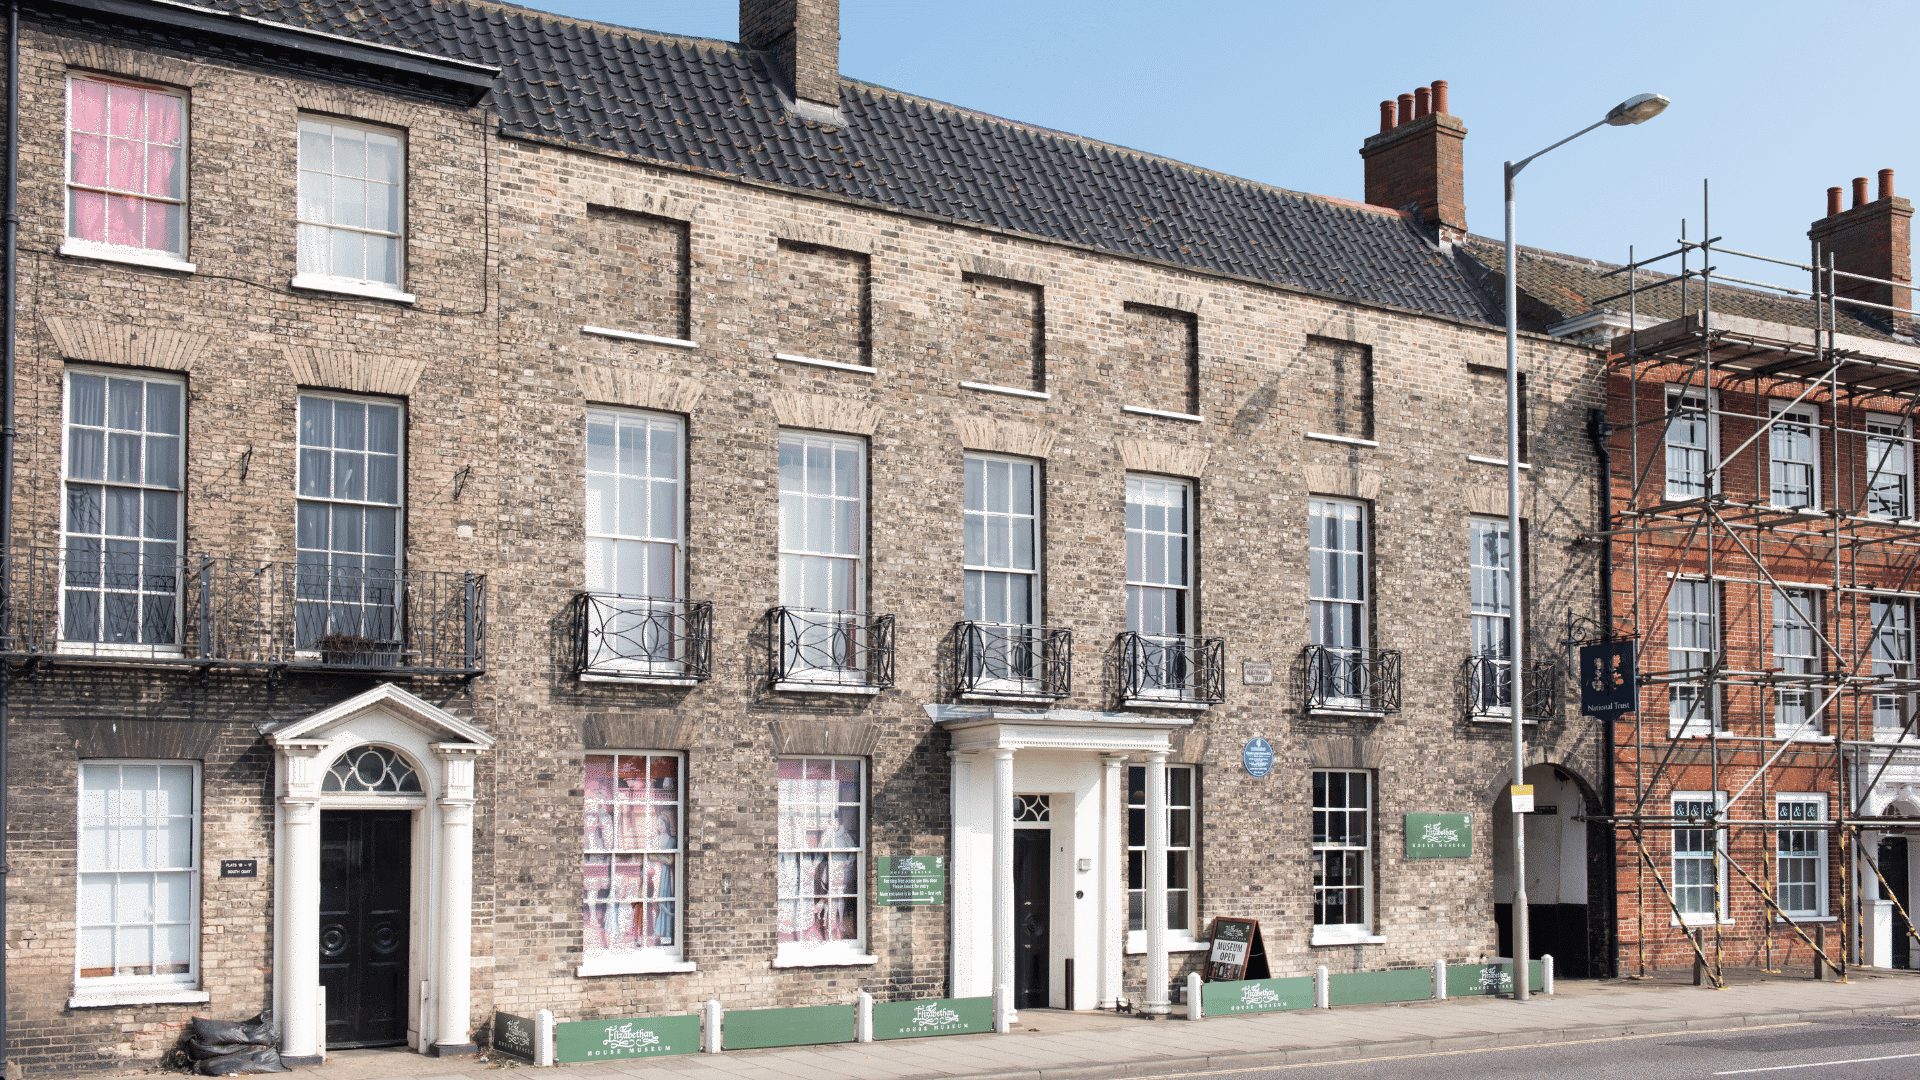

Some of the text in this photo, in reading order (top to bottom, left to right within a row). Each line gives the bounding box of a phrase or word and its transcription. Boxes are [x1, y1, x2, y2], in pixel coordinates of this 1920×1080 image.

[1587, 701, 1613, 711] National
[1216, 941, 1243, 952] MUSEUM
[1220, 951, 1236, 962] OPEN
[1241, 983, 1279, 1005] Elizabethan
[912, 1002, 959, 1026] Elizabethan
[933, 1023, 969, 1031] MUSEUM
[603, 1022, 660, 1048] Elizabethan
[587, 1045, 671, 1057] HOUSE MUSEUM
